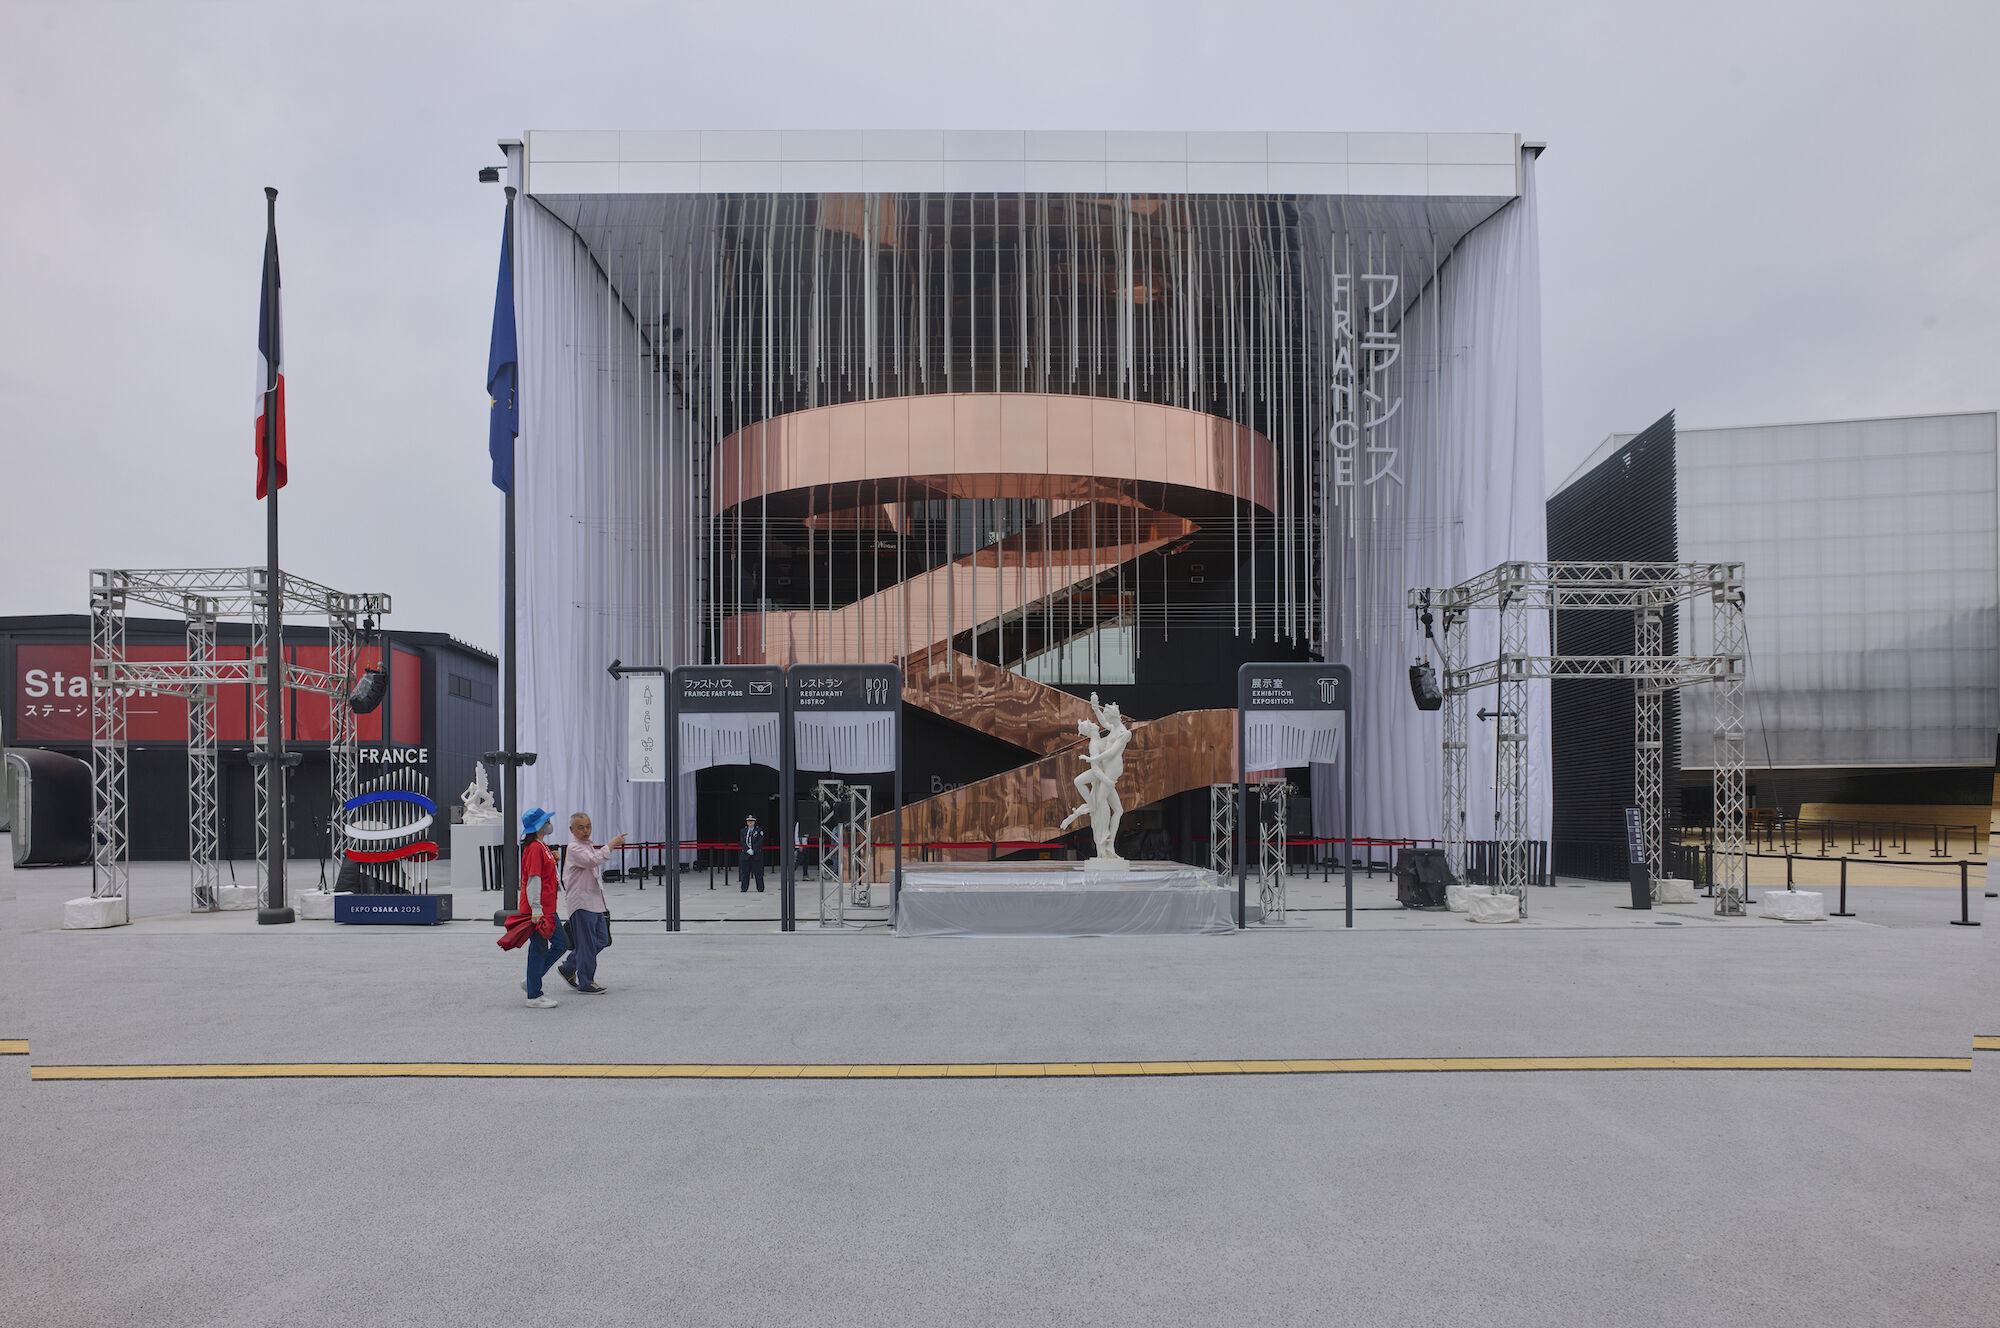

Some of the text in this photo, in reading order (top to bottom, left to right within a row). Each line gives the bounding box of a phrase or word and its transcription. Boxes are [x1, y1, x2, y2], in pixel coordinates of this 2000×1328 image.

[1329, 273, 1359, 487] FRANCE
[1360, 273, 1404, 486] フランス
[25, 669, 158, 697] Staton
[684, 678, 733, 689] ファストパス
[800, 679, 843, 688] レストラン
[1252, 678, 1283, 688] 展示室
[360, 748, 428, 764] FRANCE
